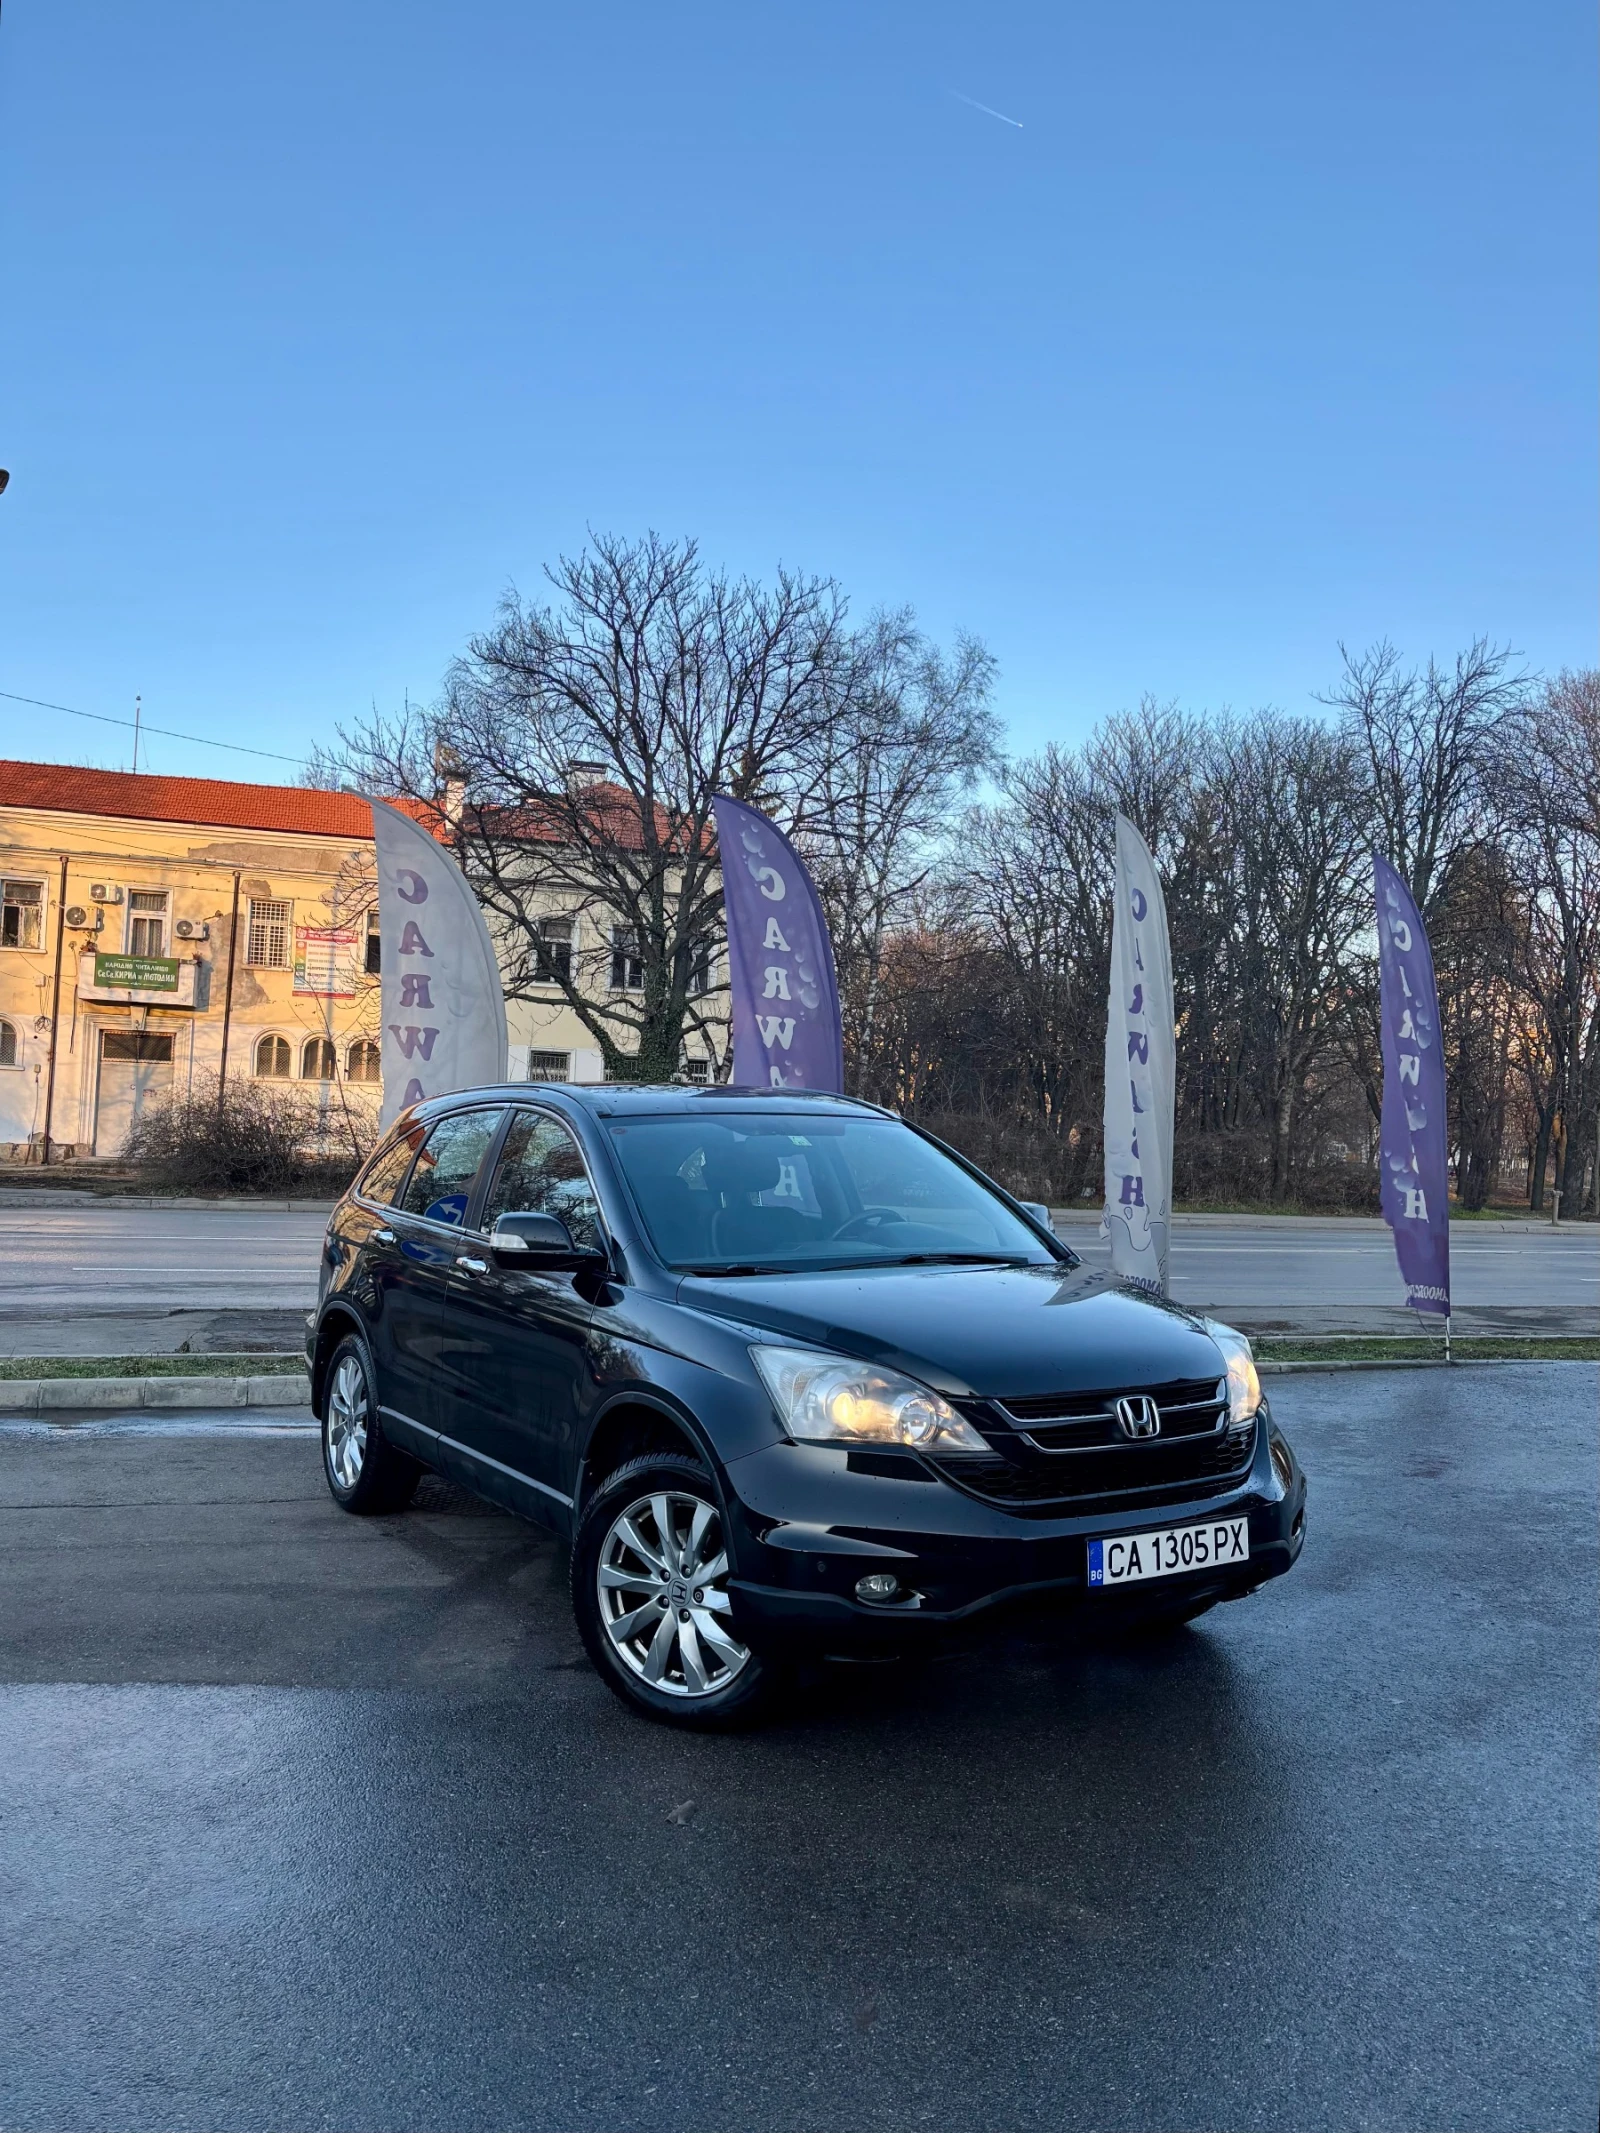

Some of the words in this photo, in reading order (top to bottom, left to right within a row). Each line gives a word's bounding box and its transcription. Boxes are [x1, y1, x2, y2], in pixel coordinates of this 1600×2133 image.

[1108, 1540, 1143, 1578] CA
[1151, 1529, 1209, 1571] 1305
[1214, 1522, 1244, 1561] PX
[1090, 1569, 1103, 1581] BG
